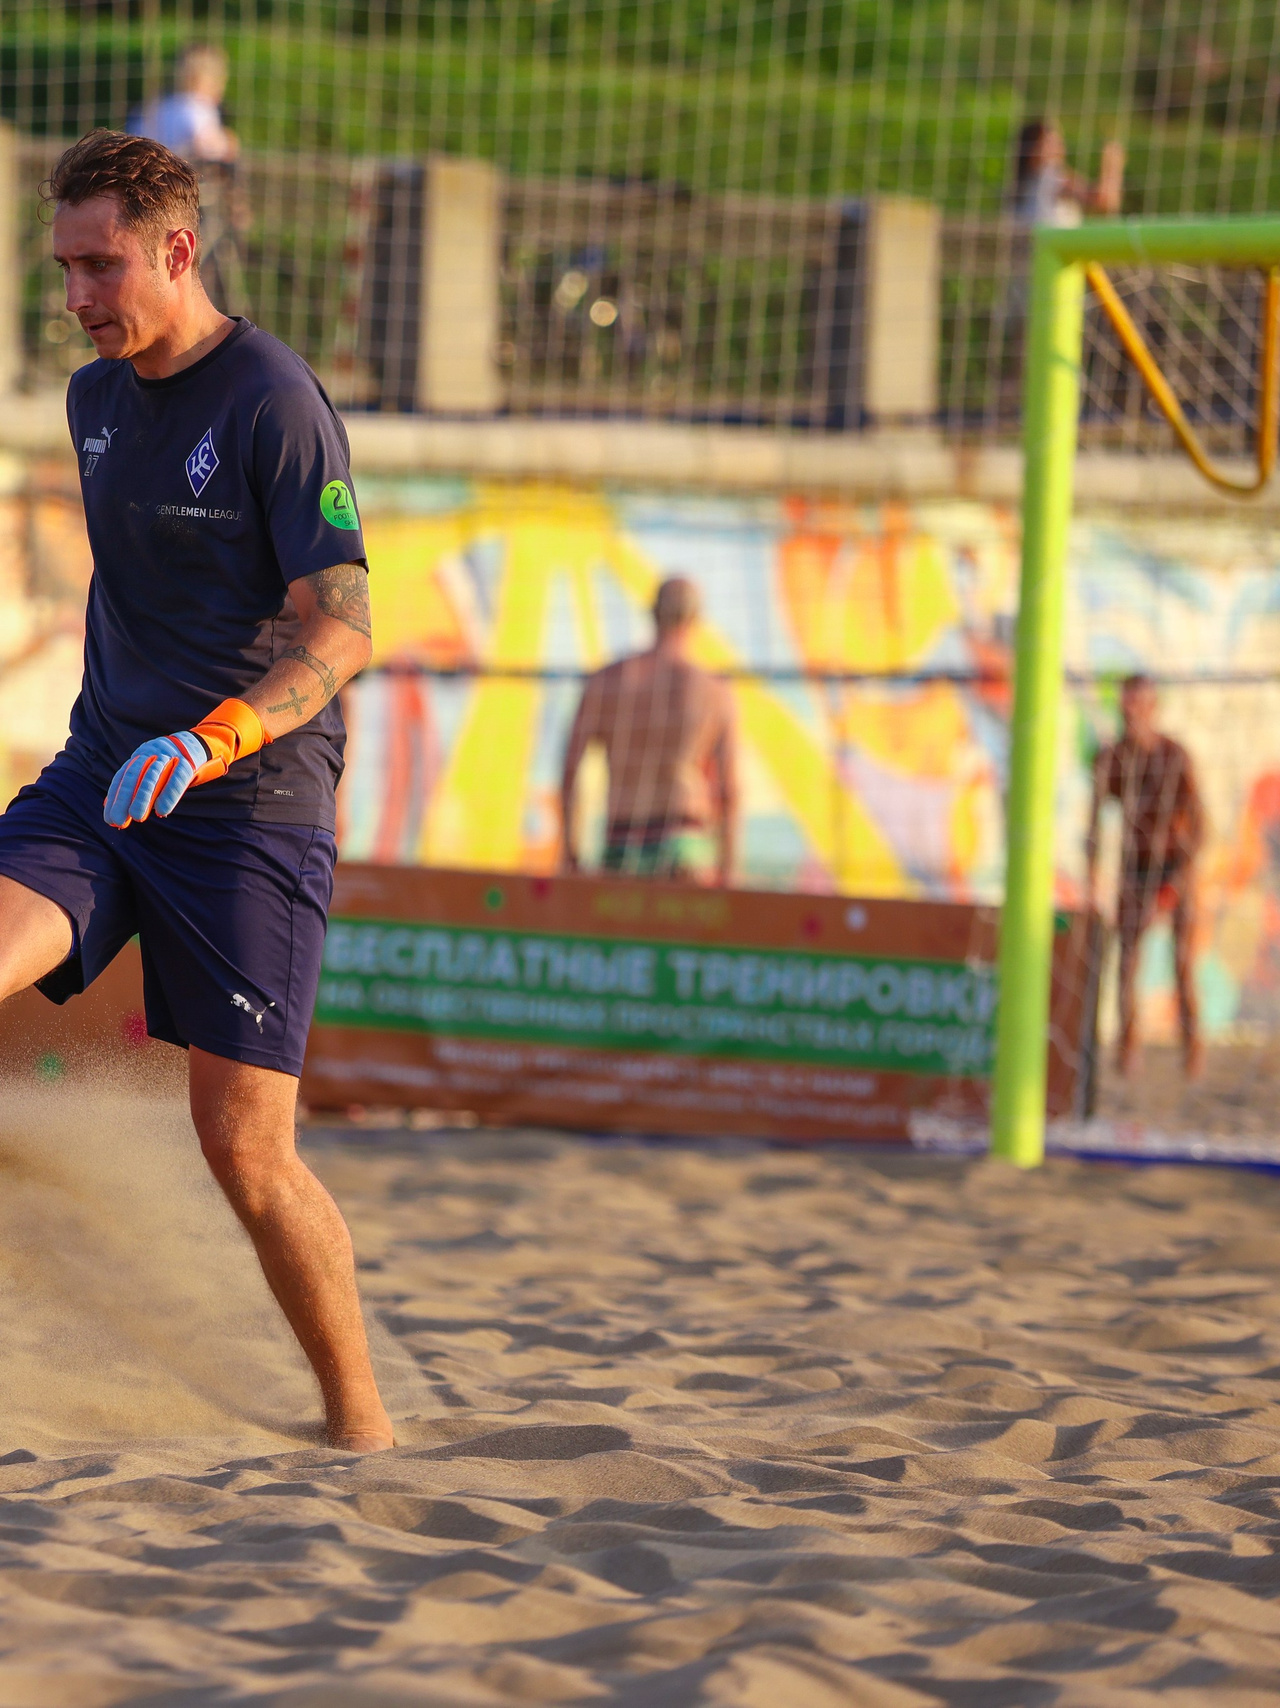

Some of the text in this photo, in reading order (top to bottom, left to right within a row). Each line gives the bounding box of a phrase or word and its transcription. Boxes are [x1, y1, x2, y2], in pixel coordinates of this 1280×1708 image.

[83, 437, 107, 454] PUMA
[84, 454, 100, 477] 27
[155, 504, 207, 518] GENTLEMEN
[323, 926, 657, 997] БЕСПЛАТНЫЕ
